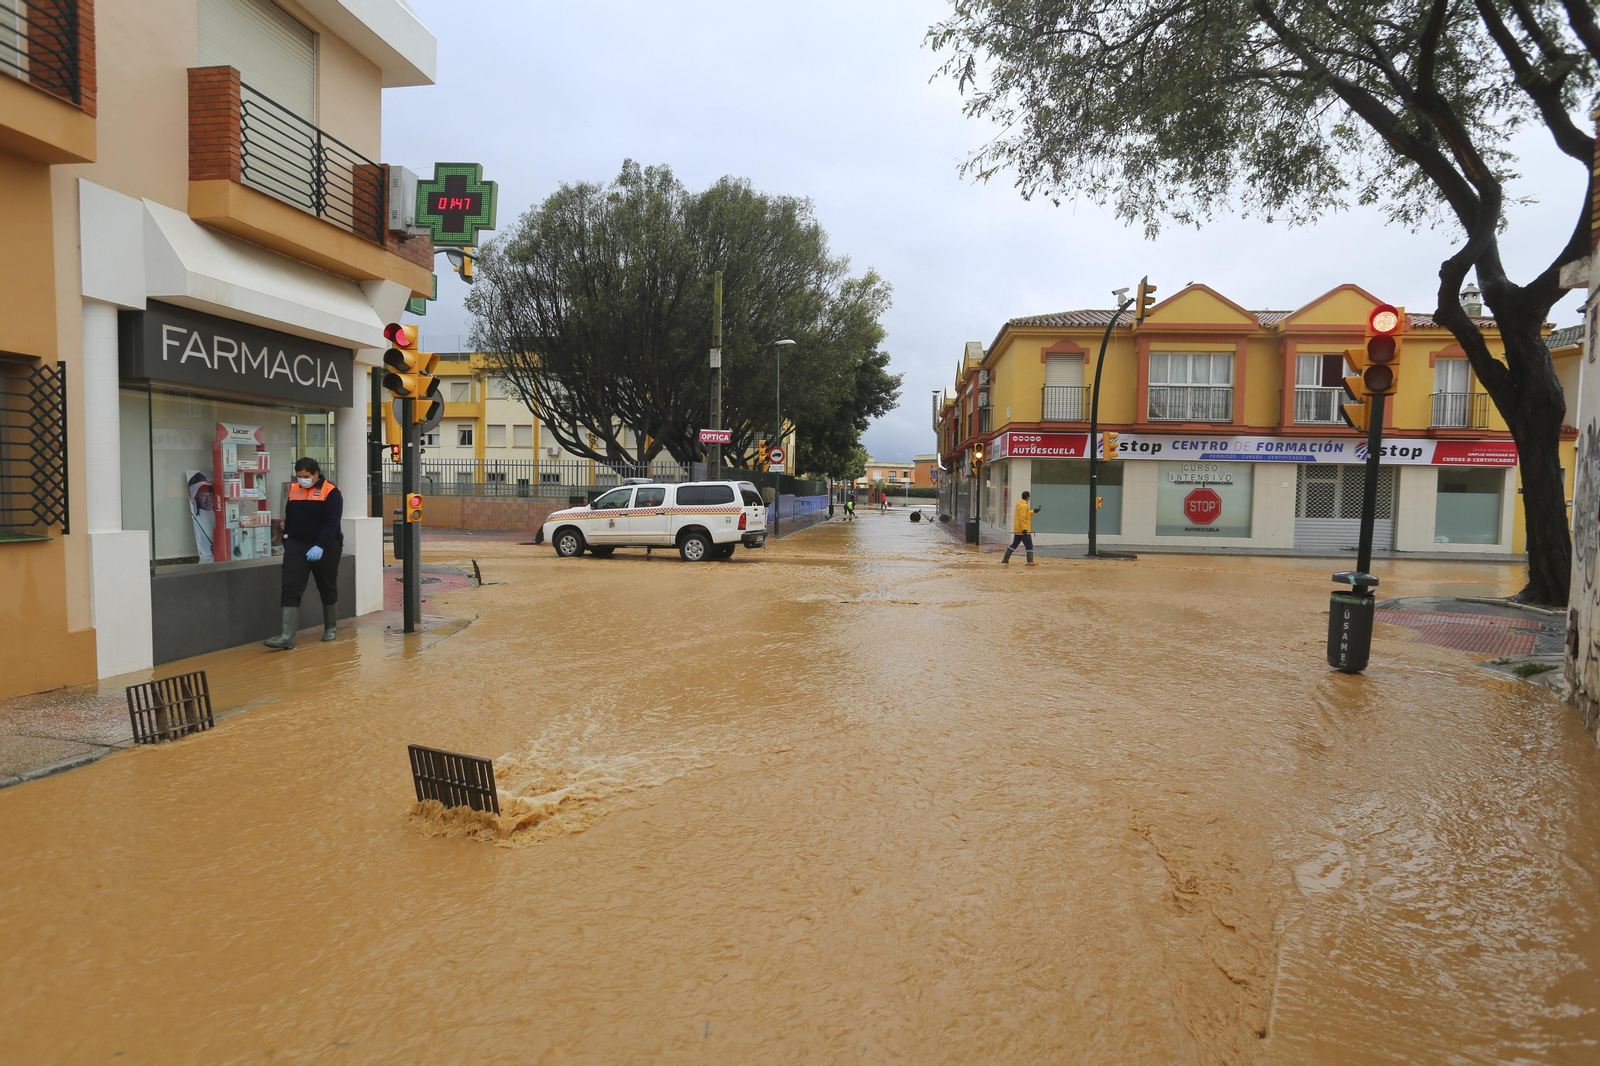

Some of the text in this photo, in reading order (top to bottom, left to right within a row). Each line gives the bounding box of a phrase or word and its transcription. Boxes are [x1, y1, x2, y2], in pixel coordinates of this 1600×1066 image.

[162, 324, 343, 392] FARMACIA
[232, 427, 250, 435] Lacer
[701, 433, 729, 441] OPTICA
[1012, 447, 1076, 455] AUTOESCUELA
[1119, 440, 1162, 455] stop
[1171, 440, 1345, 453] CENTRO DE FORMACIÓN
[1379, 444, 1423, 460] stop
[1183, 463, 1218, 472] CURSO
[1170, 473, 1232, 482] INTENSIVO
[1190, 500, 1216, 512] STOP
[1340, 609, 1350, 661] ÚSAME
